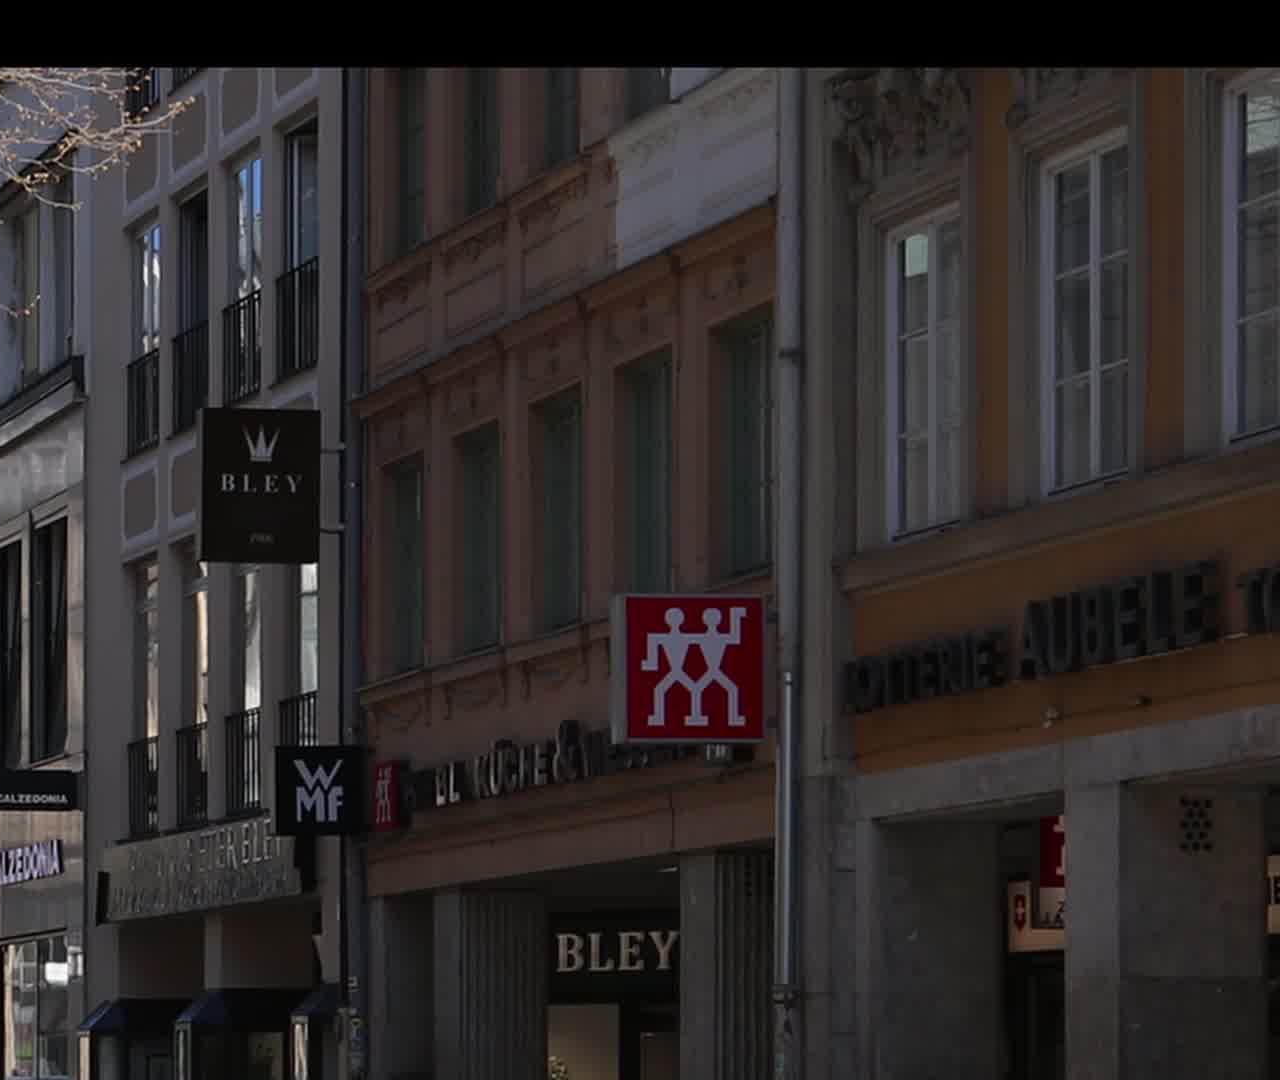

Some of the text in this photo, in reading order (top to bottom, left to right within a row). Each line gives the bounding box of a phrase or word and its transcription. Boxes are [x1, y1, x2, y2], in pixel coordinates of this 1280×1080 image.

[221, 472, 304, 494] BLEY
[293, 759, 344, 823] WMF
[555, 931, 680, 973] BLEY
